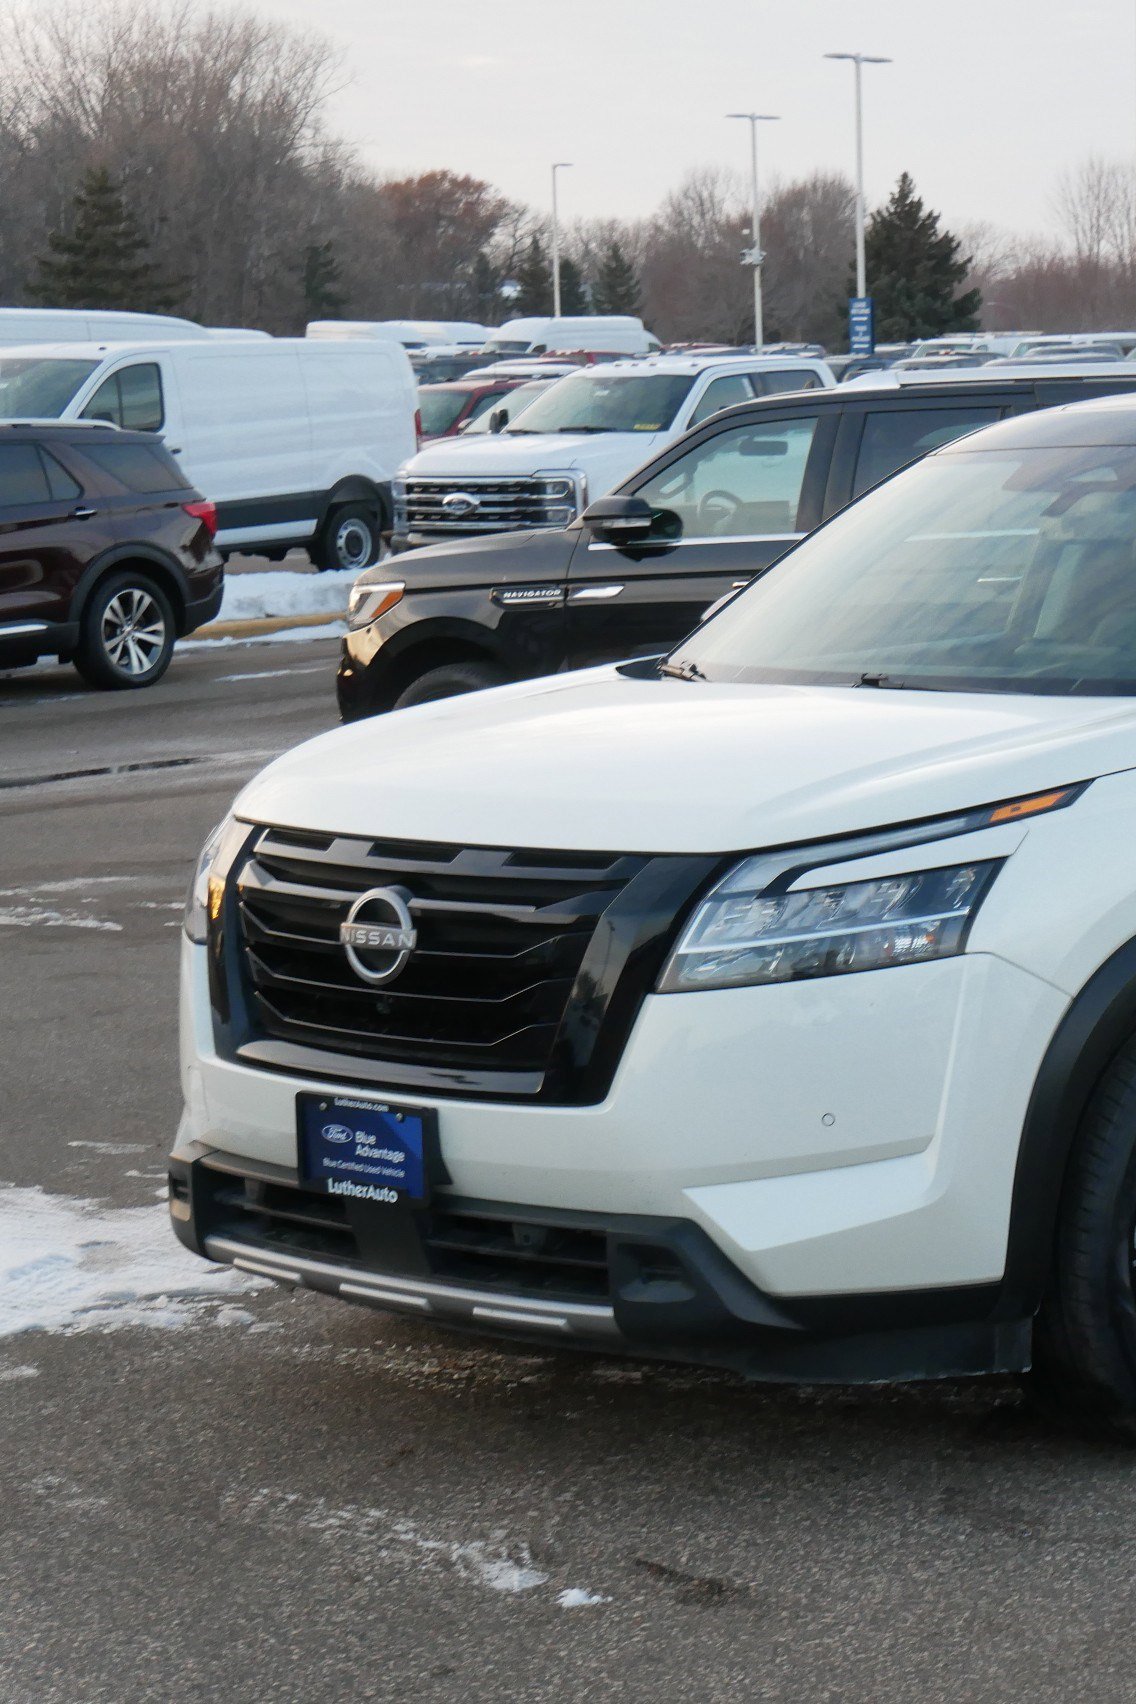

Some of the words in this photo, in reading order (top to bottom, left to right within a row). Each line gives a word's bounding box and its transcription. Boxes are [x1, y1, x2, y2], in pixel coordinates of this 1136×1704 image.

[503, 589, 561, 598] NAVIGATOR
[341, 926, 414, 947] NISSAN
[325, 1125, 348, 1141] Ford
[355, 1130, 376, 1145] Blue
[355, 1145, 405, 1163] Advantage
[322, 1157, 337, 1168] Blue
[327, 1177, 398, 1203] LutherAuto
